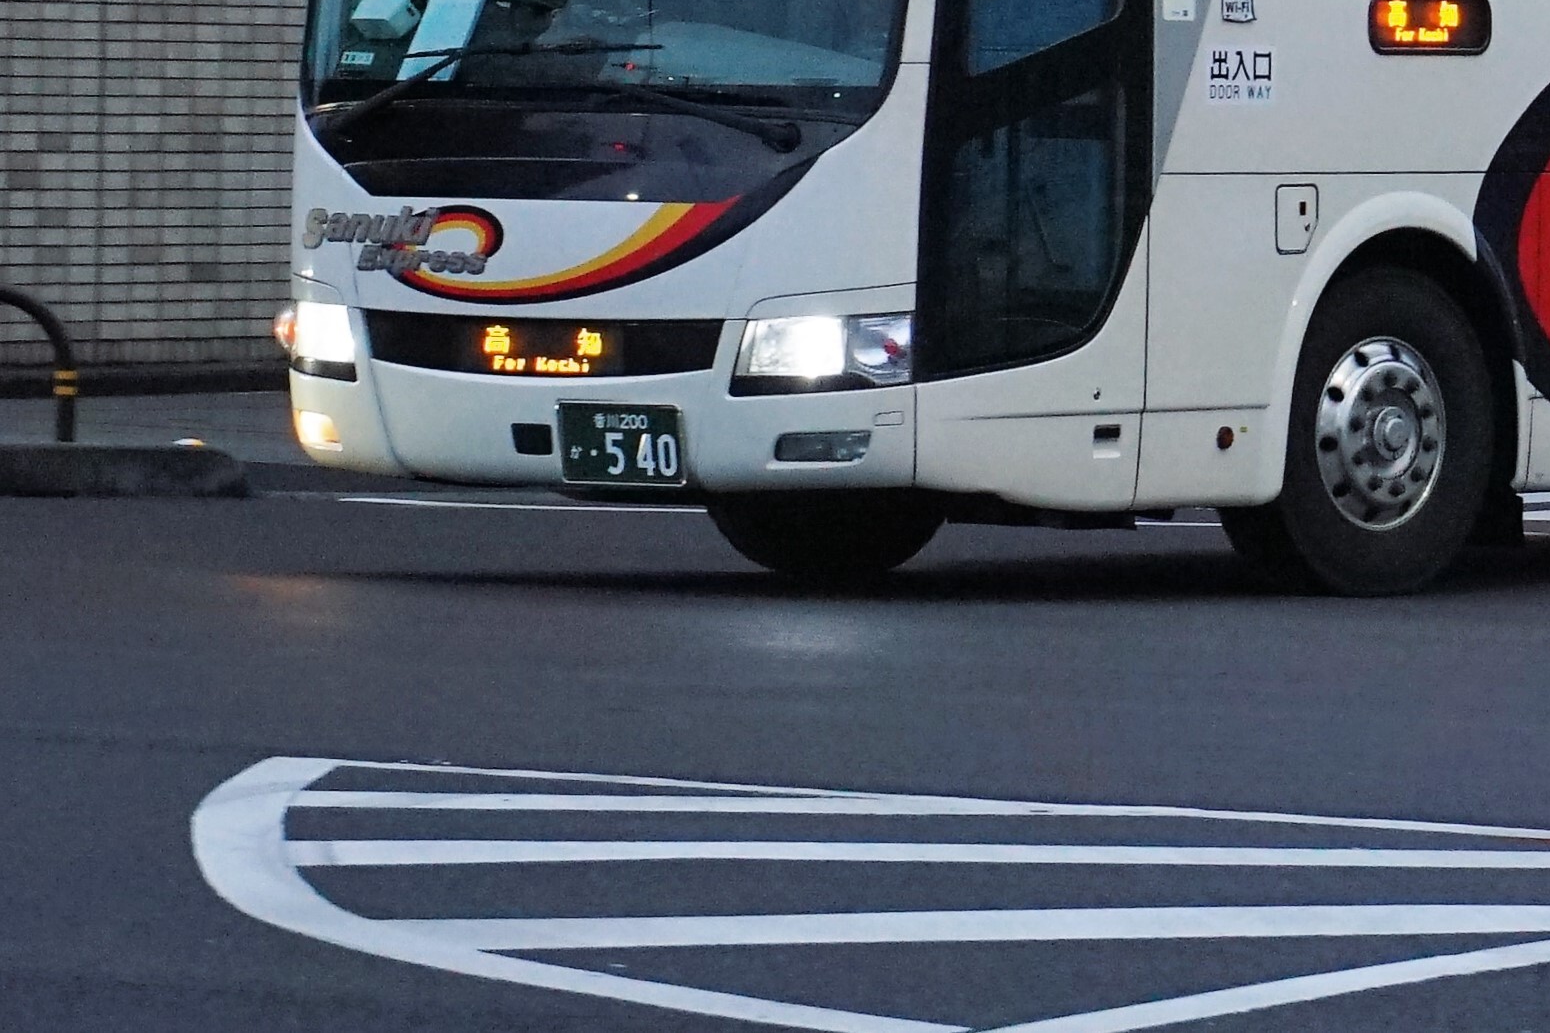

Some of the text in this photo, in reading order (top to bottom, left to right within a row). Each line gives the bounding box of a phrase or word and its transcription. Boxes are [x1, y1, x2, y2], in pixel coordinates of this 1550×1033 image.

[1225, 1, 1250, 13] Wi-Fi
[1210, 50, 1272, 81] 出入口
[1209, 85, 1272, 99] DOOR WAY
[303, 205, 439, 249] Sanuki
[357, 245, 488, 275] Express
[493, 355, 590, 373] For Kochi
